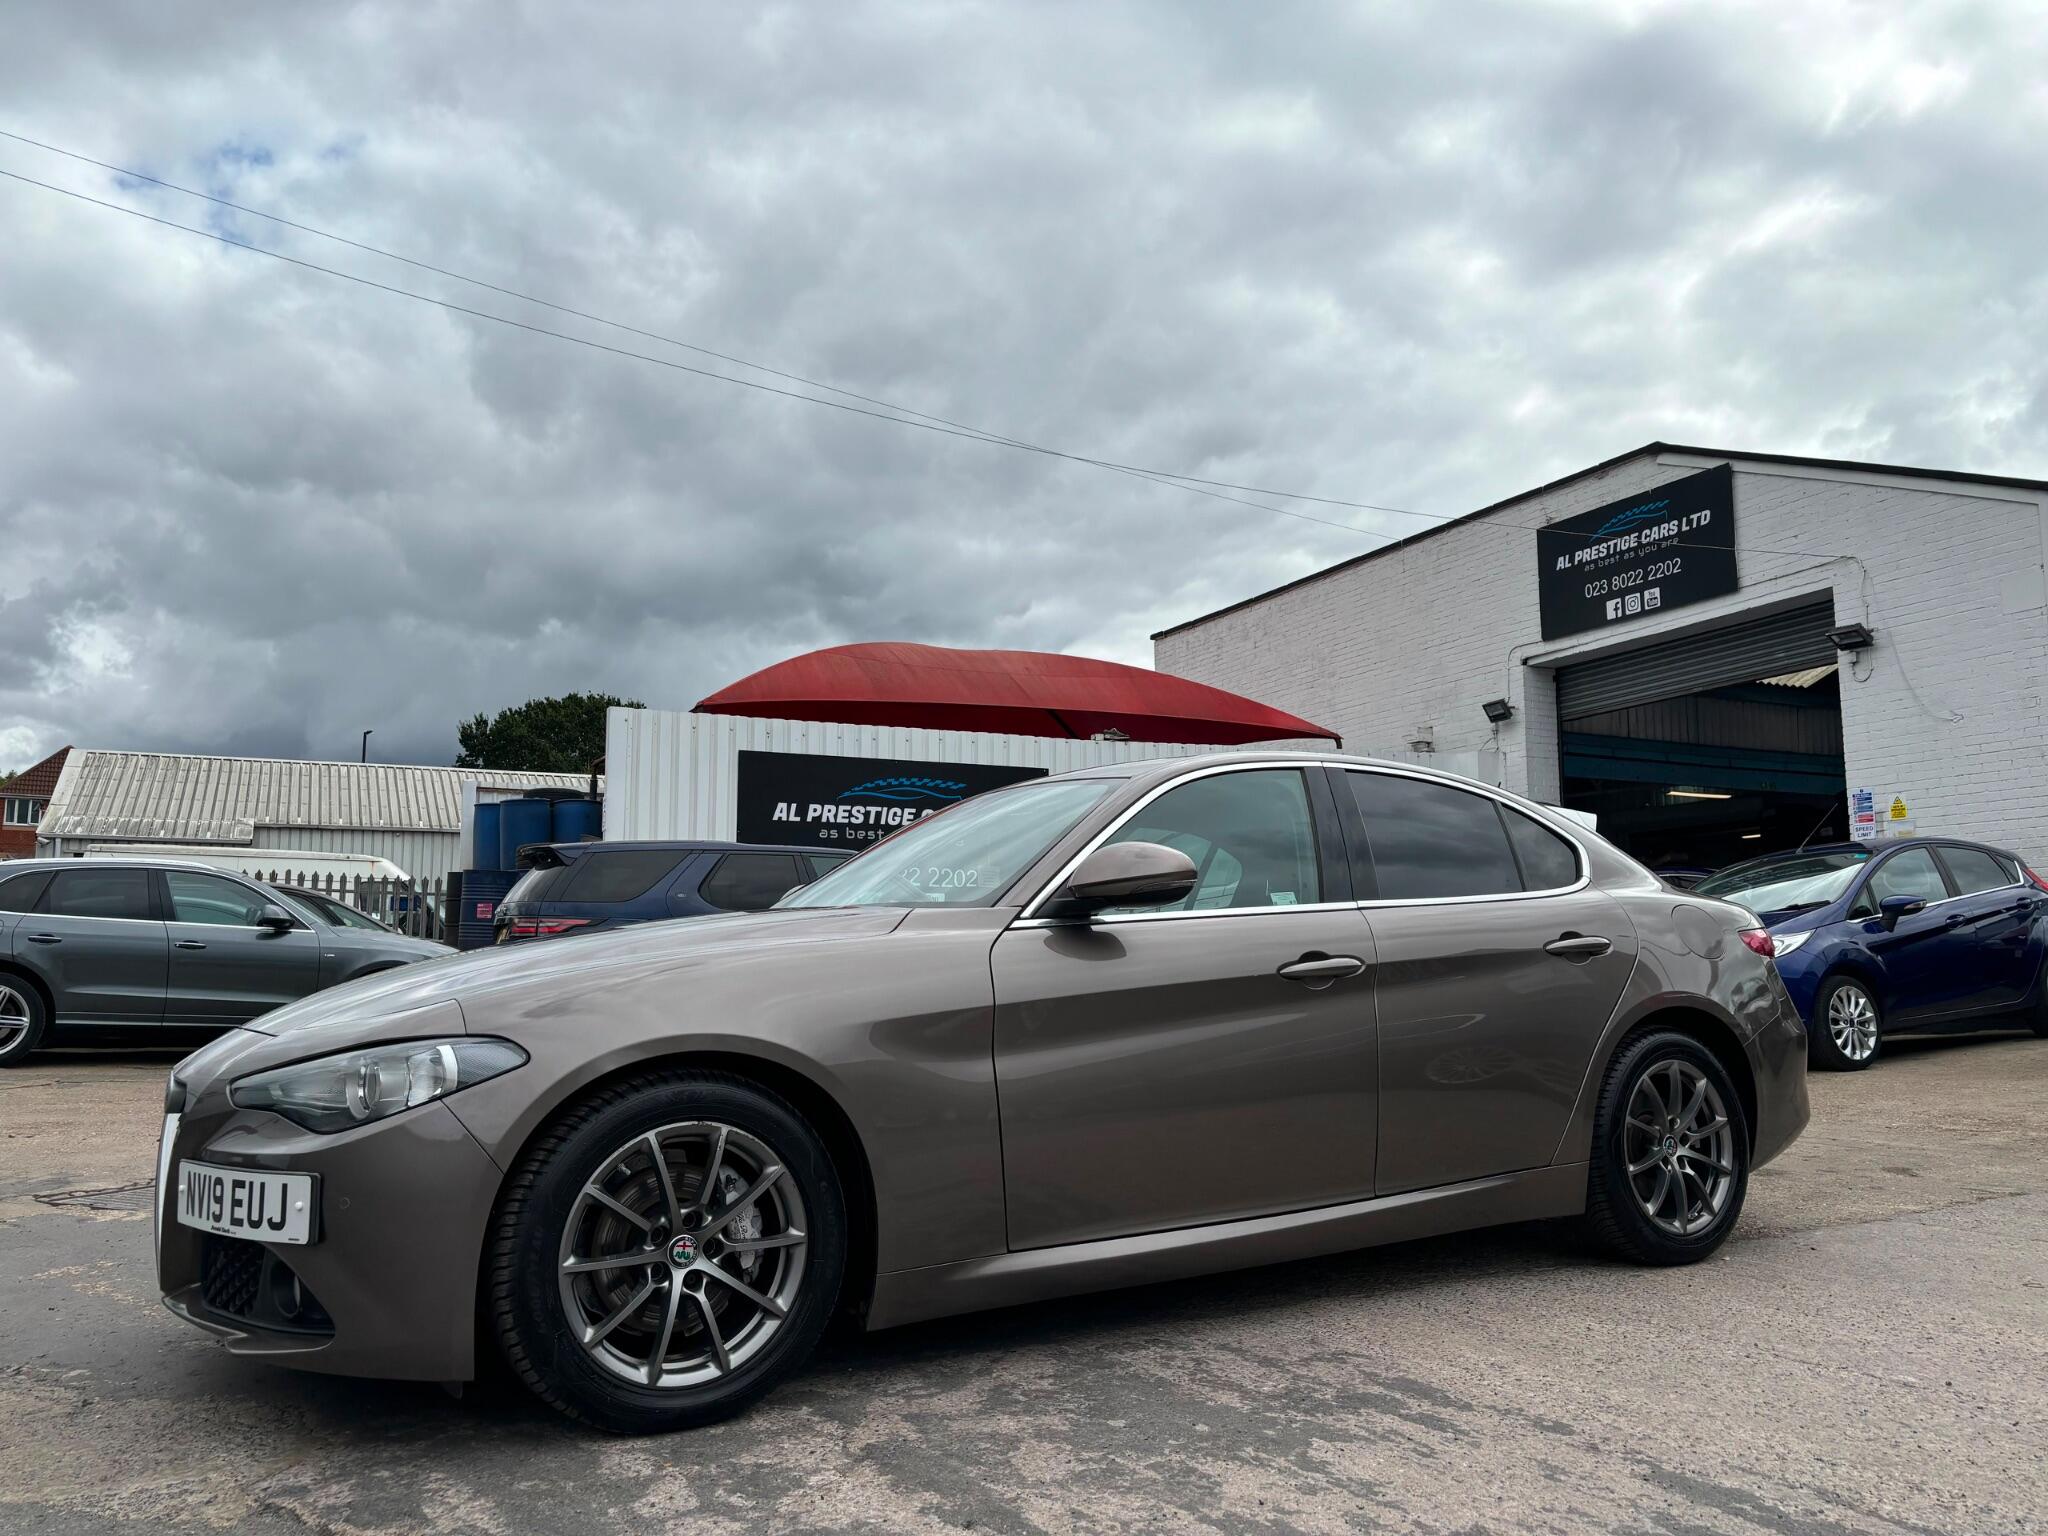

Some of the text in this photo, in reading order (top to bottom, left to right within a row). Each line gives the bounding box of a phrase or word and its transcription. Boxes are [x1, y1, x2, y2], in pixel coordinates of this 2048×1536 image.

[1556, 509, 1711, 571] AL PRESTIGE CARS LTD
[1584, 538, 1680, 572] as best as you are
[1584, 558, 1682, 598] 023 8022 2202
[772, 802, 801, 822] AL
[806, 803, 917, 826] PRESTIGE
[819, 827, 884, 840] as best
[928, 867, 977, 888] 2202
[186, 1170, 288, 1231] NV19 EUJ
